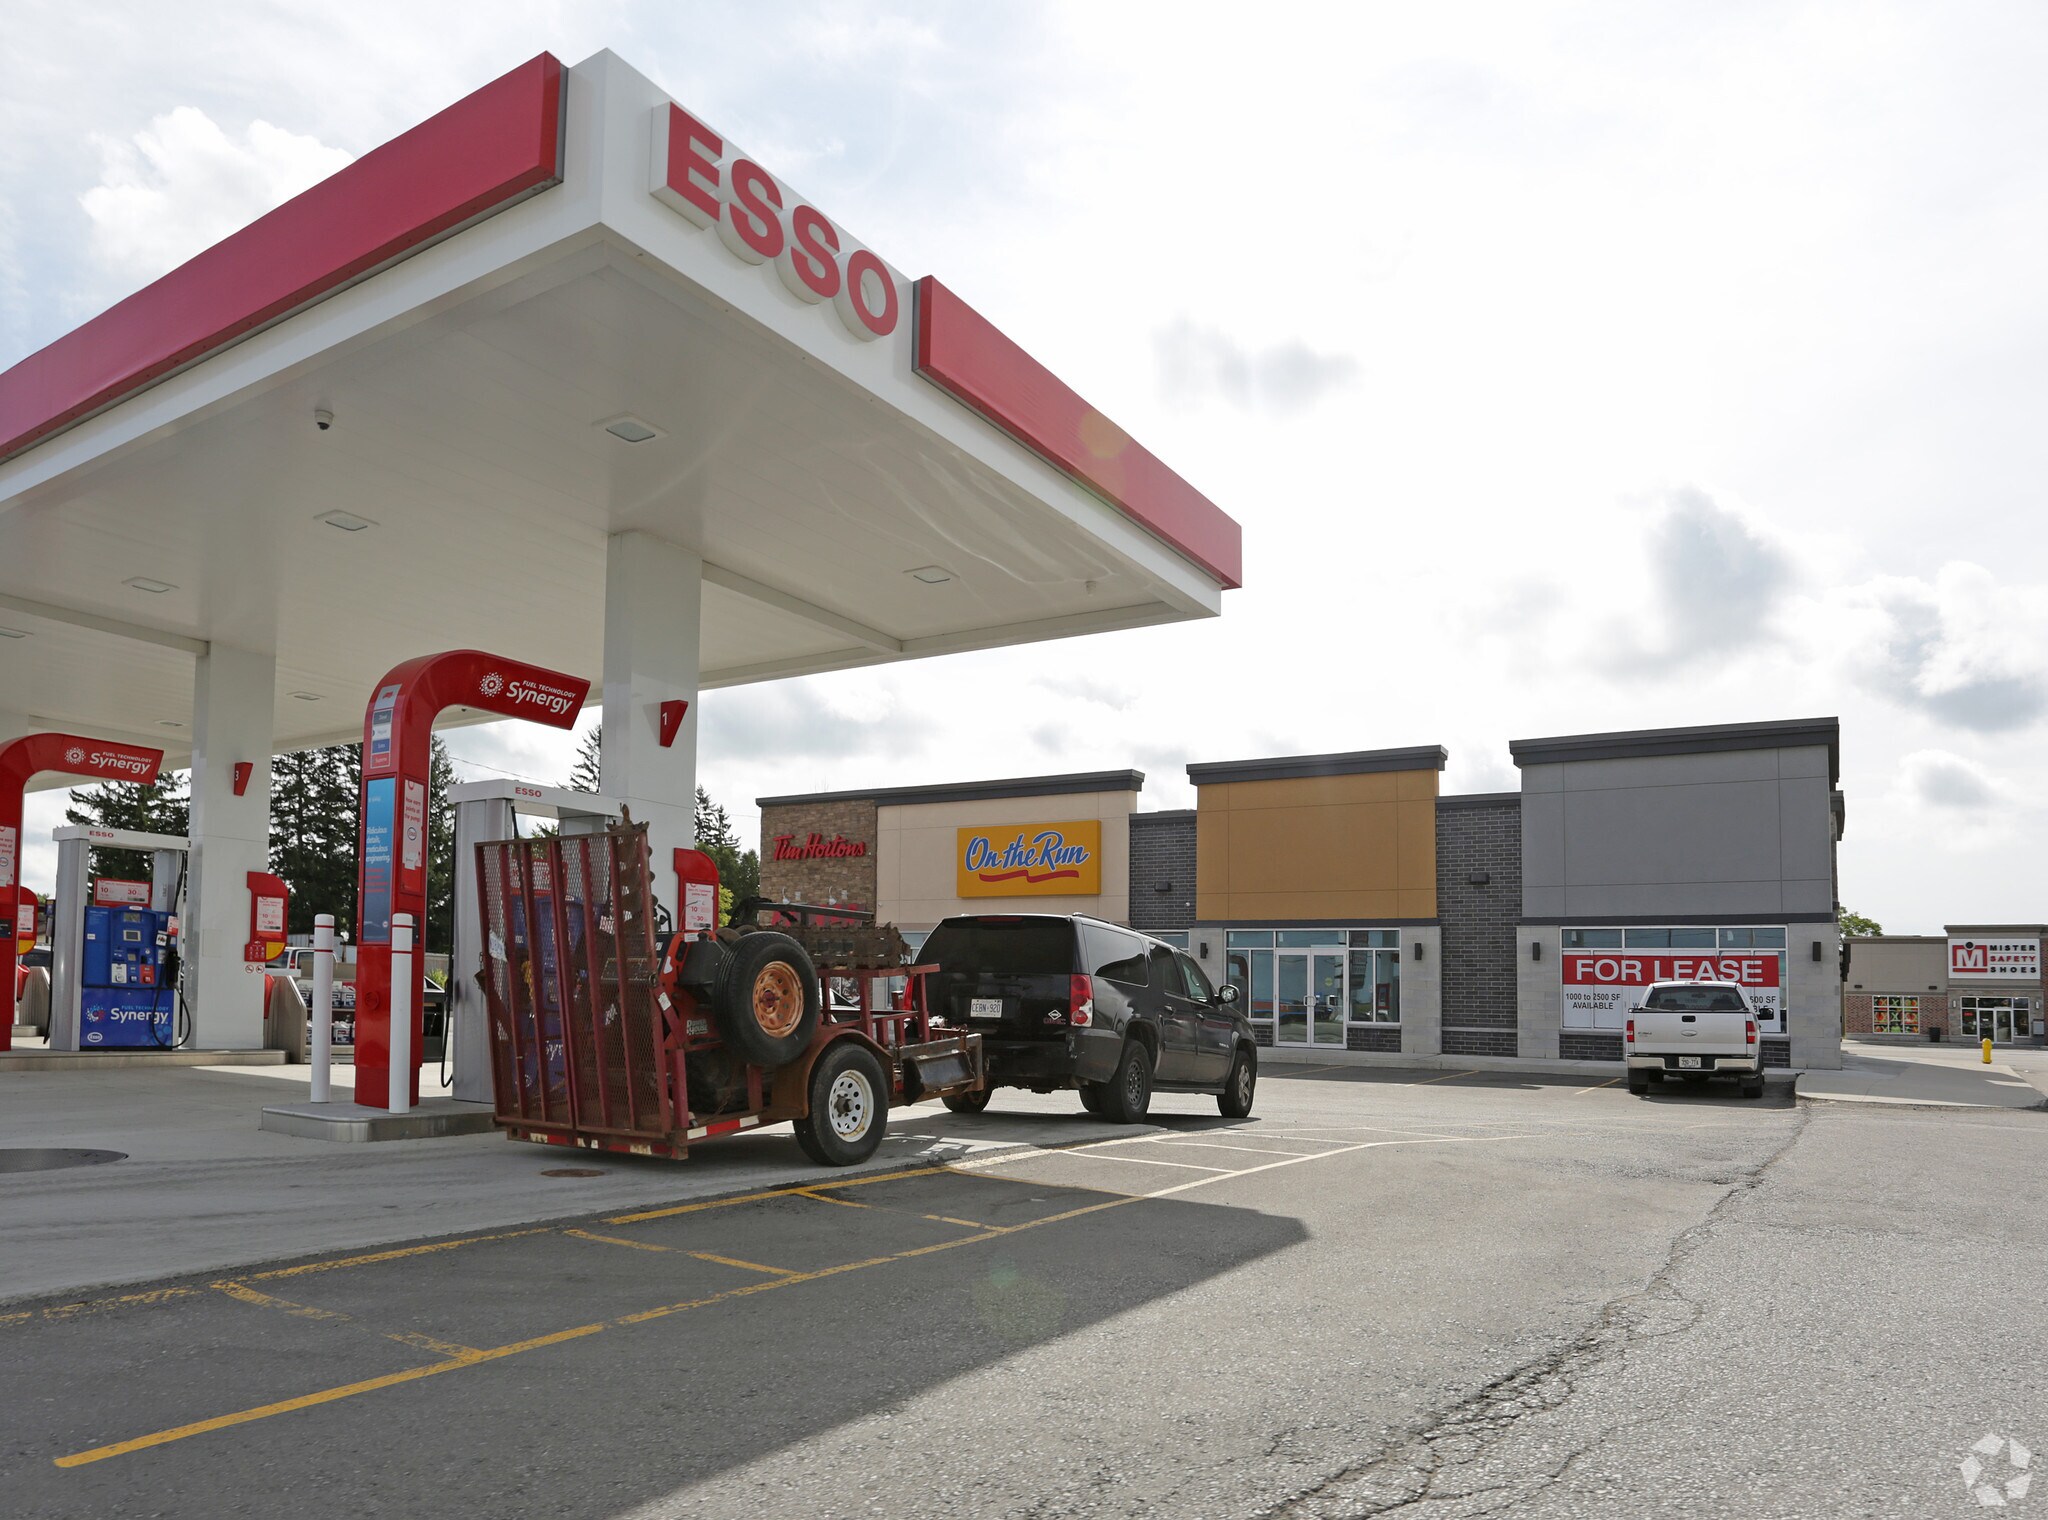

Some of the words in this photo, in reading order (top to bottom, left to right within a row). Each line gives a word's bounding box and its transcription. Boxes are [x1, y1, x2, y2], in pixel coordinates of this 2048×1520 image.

[664, 100, 899, 338] ESSO
[522, 680, 537, 690] FUEL
[538, 684, 577, 698] TECHNOLOGY
[506, 681, 573, 715] Synergy
[662, 712, 668, 726] 1
[89, 752, 151, 775] Synergy
[117, 754, 153, 763] TECHNOLOGY
[515, 786, 542, 798] ESSO
[88, 830, 114, 838] ESSO
[772, 834, 803, 861] Tim
[803, 832, 865, 859] Hortons
[965, 836, 1002, 872] On
[1002, 833, 1039, 869] the
[1032, 831, 1090, 872] Run
[1989, 944, 2036, 952] MISTER
[1576, 958, 1642, 982] FOR
[1653, 960, 1763, 983] LEASE
[1990, 966, 2037, 974] SHOES
[1565, 993, 1582, 1001] 1000
[1583, 993, 1591, 1001] to
[1592, 993, 1610, 1001] 2500
[1611, 993, 1621, 1001] SF
[1765, 996, 1777, 1004] SF
[1572, 1001, 1614, 1010] AVAILABLE
[110, 1008, 169, 1024] Synergy
